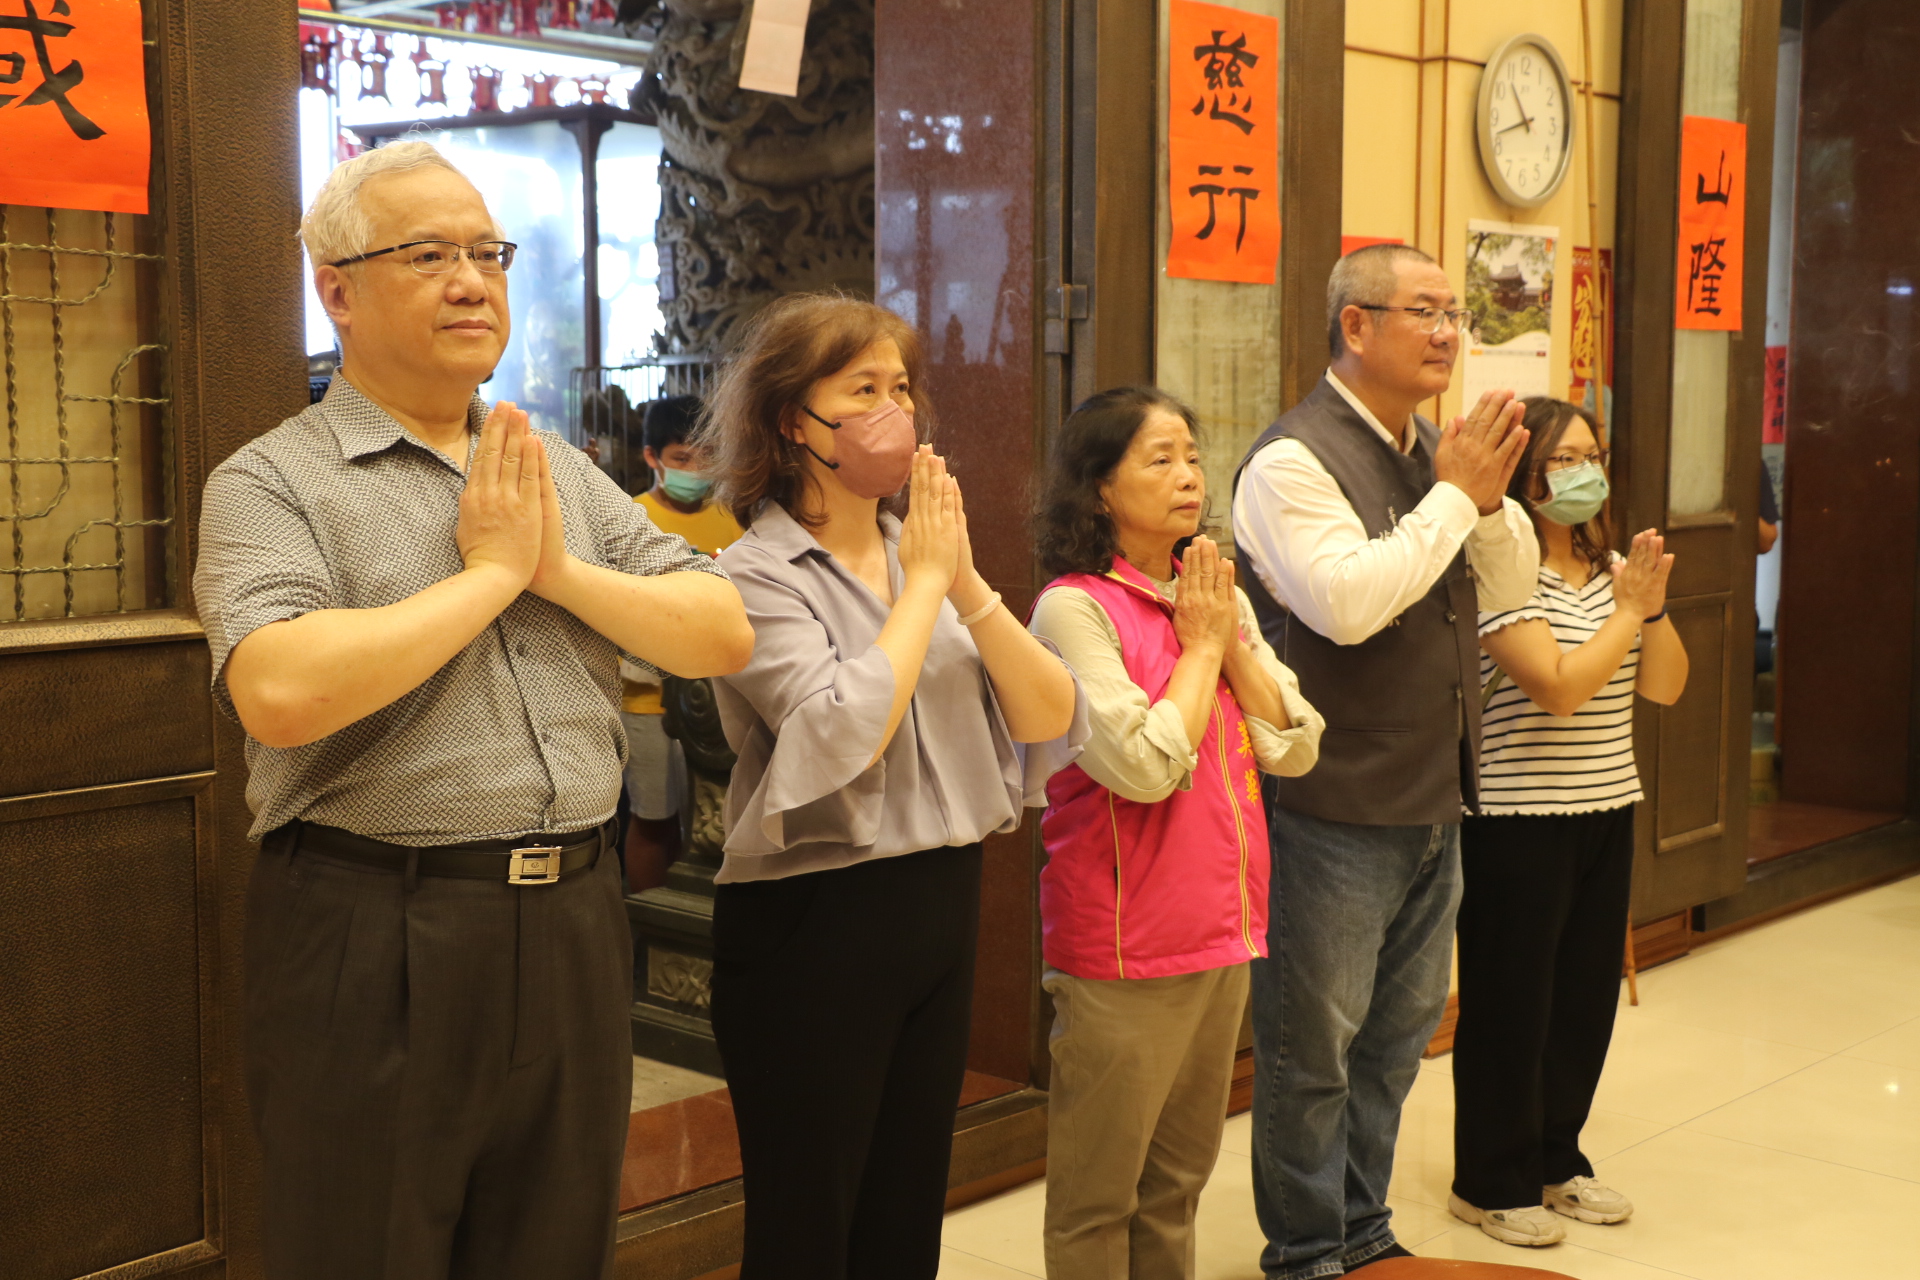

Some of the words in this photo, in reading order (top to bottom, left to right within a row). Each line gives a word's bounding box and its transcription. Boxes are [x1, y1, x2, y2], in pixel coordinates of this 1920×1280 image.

[1507, 62, 1515, 80] 11
[1521, 56, 1531, 75] 12
[1495, 82, 1505, 100] 10
[1546, 86, 1554, 106] 2
[1490, 107, 1499, 127] 9
[1549, 117, 1556, 136] 3
[1188, 30, 1261, 255] 慈行
[1493, 135, 1502, 155] 8
[1543, 144, 1550, 162] 4
[1505, 159, 1513, 178] 7
[1518, 168, 1526, 187] 6
[1533, 163, 1540, 182] 5
[1687, 150, 1732, 316] 山隆
